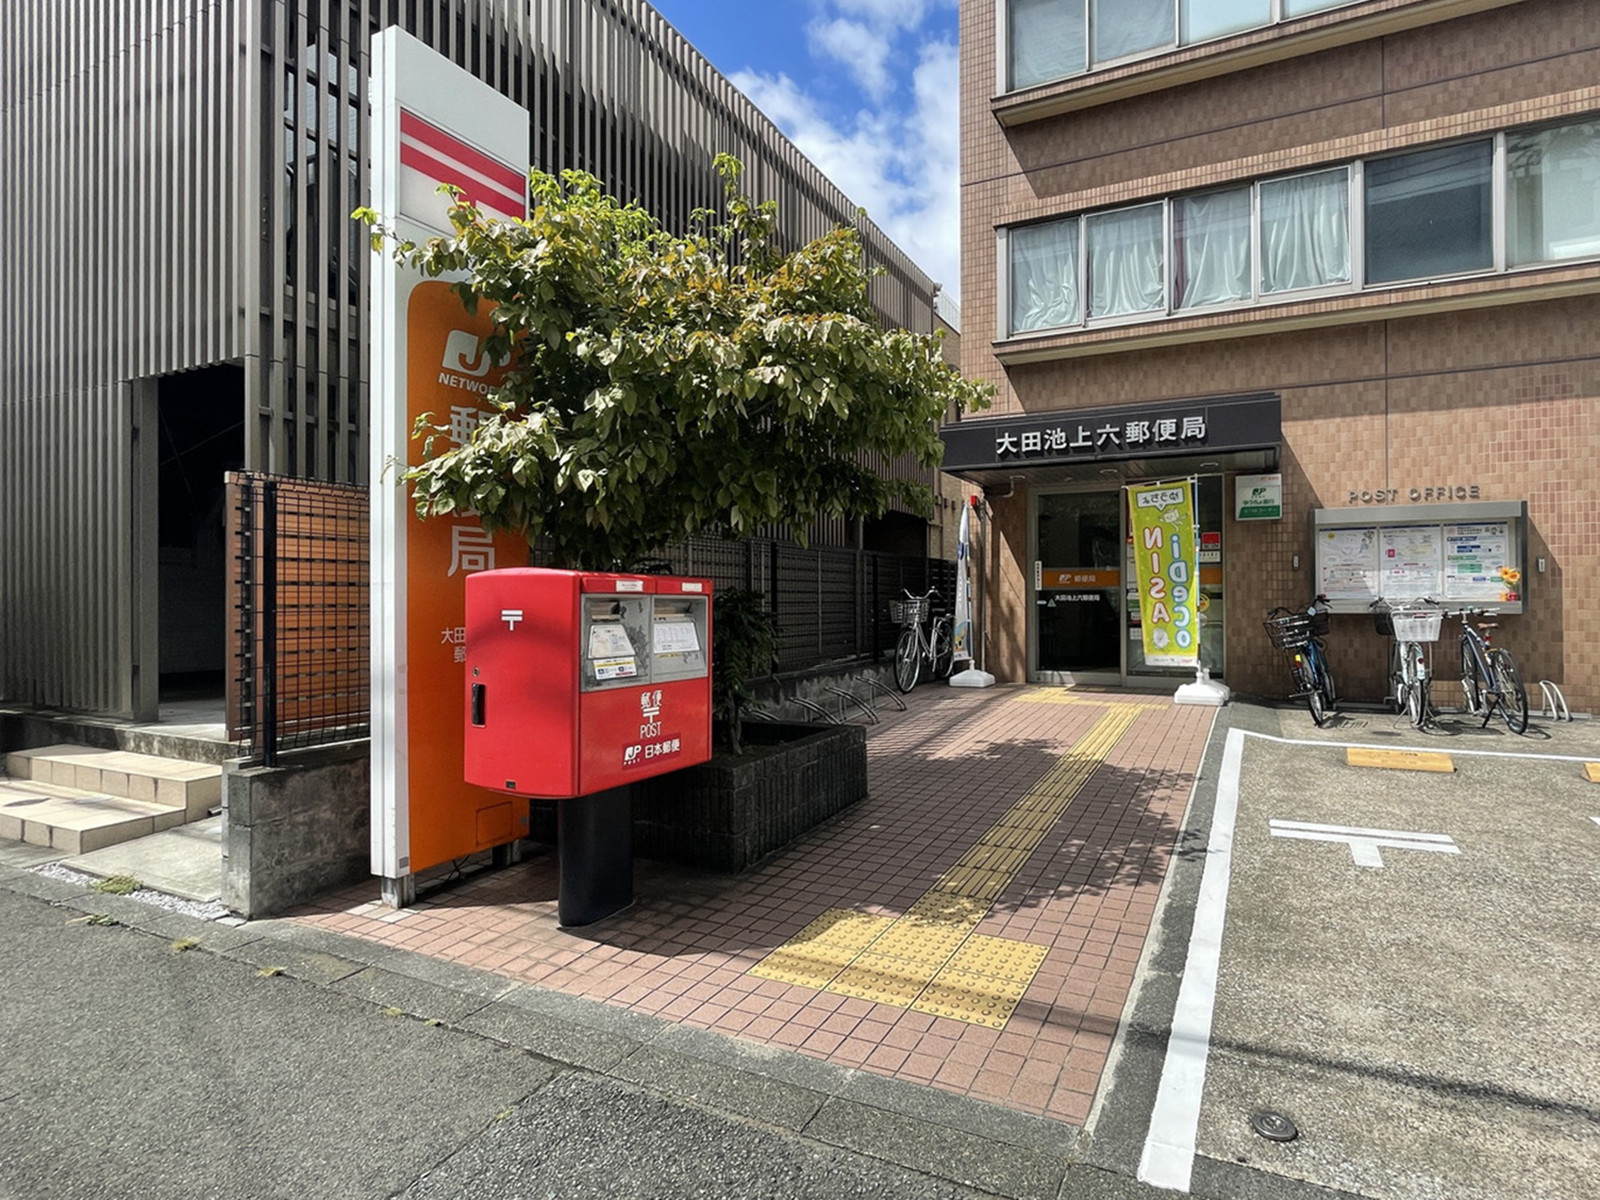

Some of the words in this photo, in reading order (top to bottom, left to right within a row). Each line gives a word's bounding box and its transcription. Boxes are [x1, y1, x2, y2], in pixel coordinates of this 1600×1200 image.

[996, 416, 1206, 454] 大田池上六郵便局
[1347, 488, 1399, 503] POST
[1408, 485, 1481, 501] OFFICE
[640, 690, 663, 709] 郵便
[639, 721, 662, 739] POST
[644, 738, 680, 759] 日本郵便
